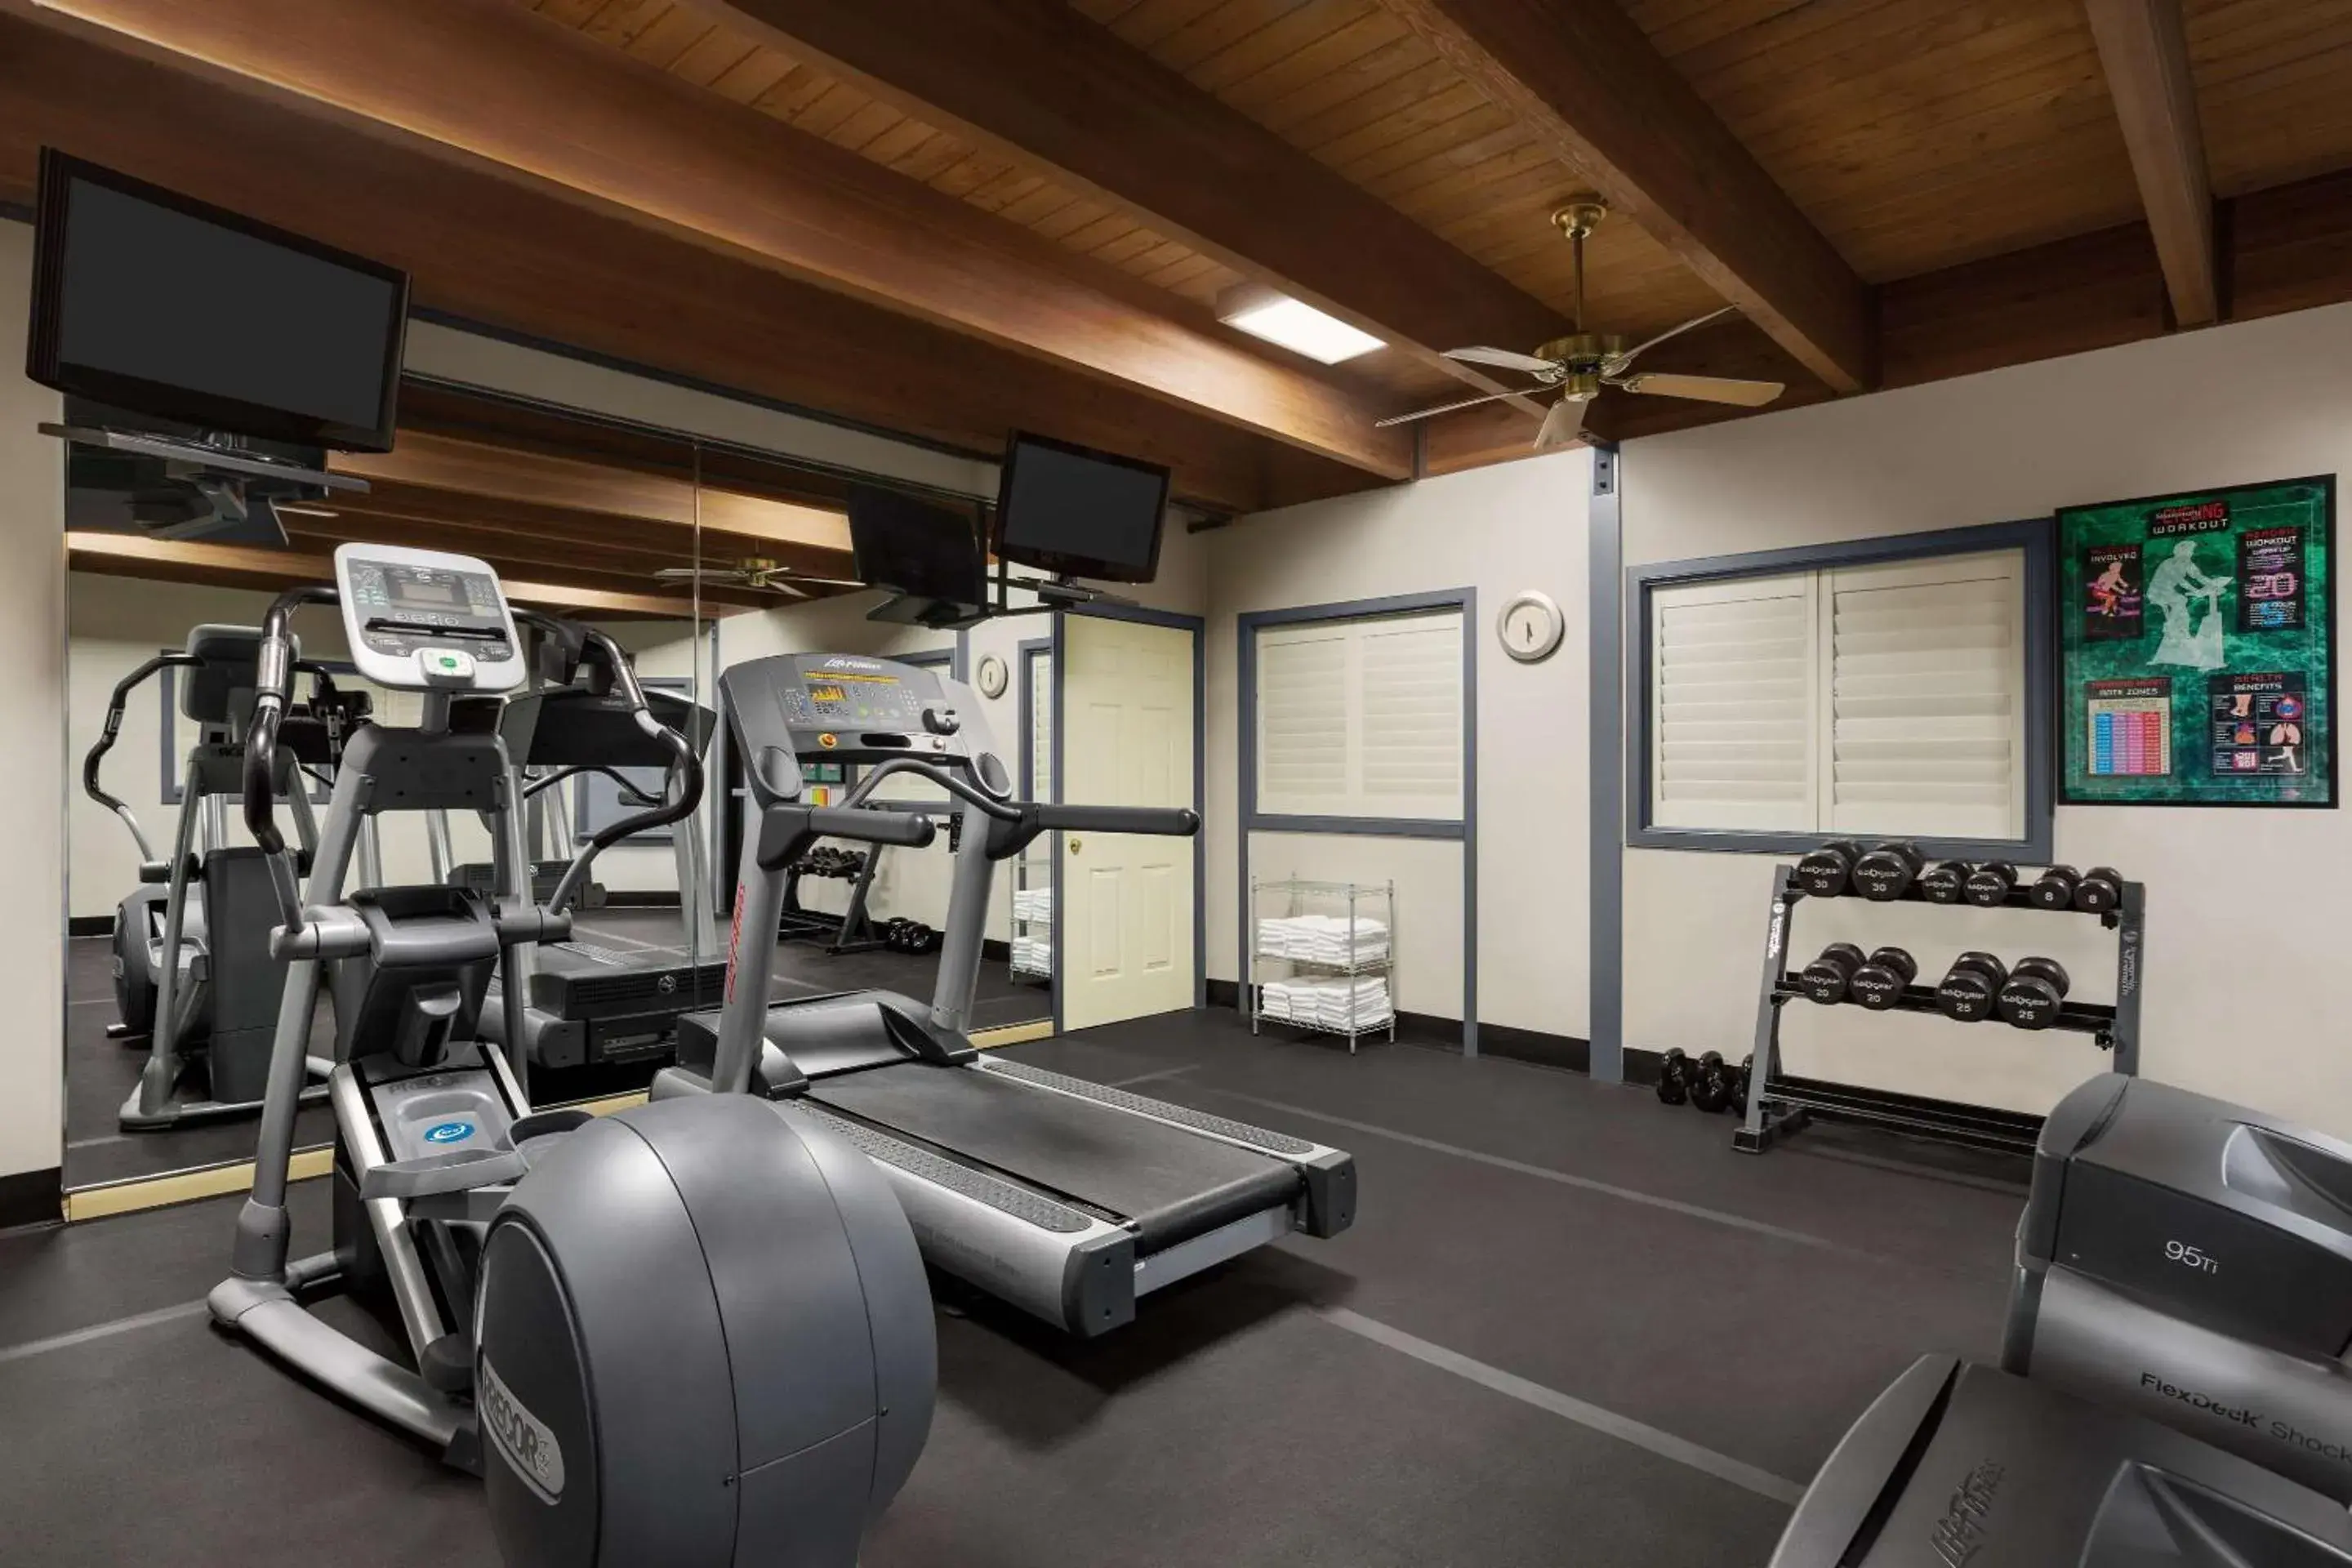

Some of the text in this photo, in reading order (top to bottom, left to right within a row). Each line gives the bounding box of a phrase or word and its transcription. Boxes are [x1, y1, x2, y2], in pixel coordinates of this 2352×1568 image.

[2152, 518, 2229, 535] WORKOUT
[2091, 551, 2137, 564] INVOLVED
[1814, 880, 1829, 889] 30
[1872, 883, 1887, 893] 30
[2044, 891, 2054, 902] 8
[1815, 988, 1829, 997] 20
[1866, 993, 1881, 1003] 20
[2164, 1240, 2219, 1275] 95Ti
[2140, 1370, 2258, 1429] FlexDeck
